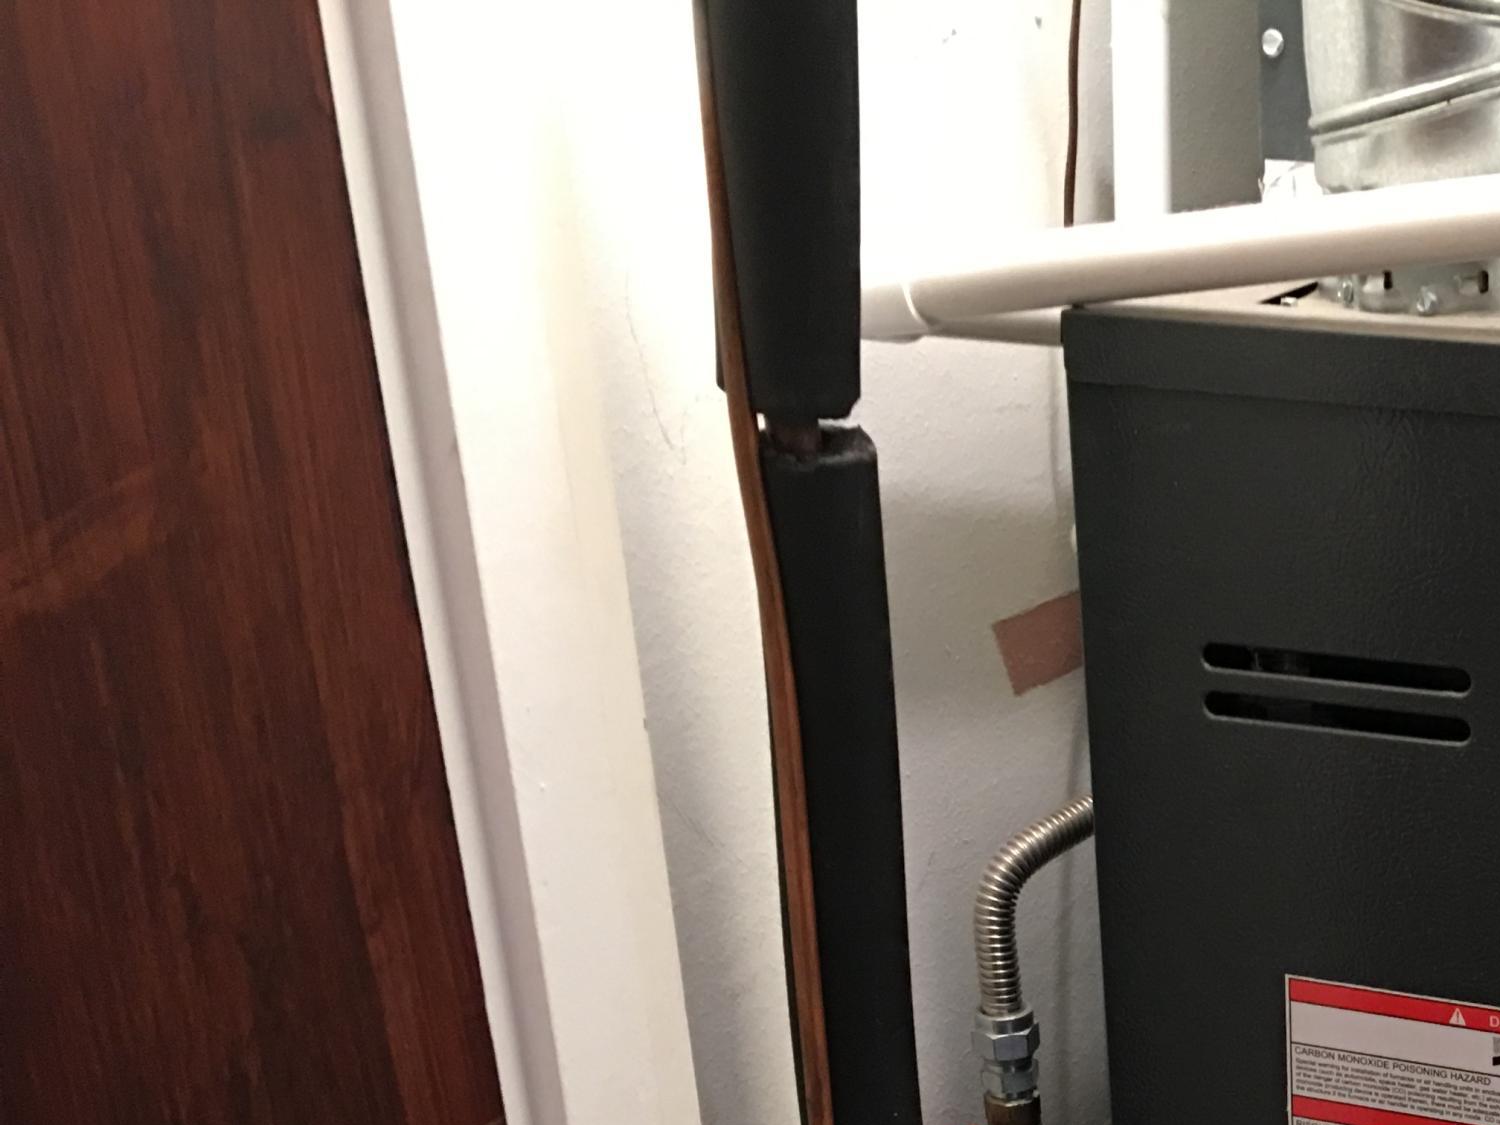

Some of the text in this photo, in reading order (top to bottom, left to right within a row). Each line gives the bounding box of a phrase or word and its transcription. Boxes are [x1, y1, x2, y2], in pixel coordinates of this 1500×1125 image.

[1294, 1046, 1491, 1085] CARBON MONOXIDE POISONING HAZARD
